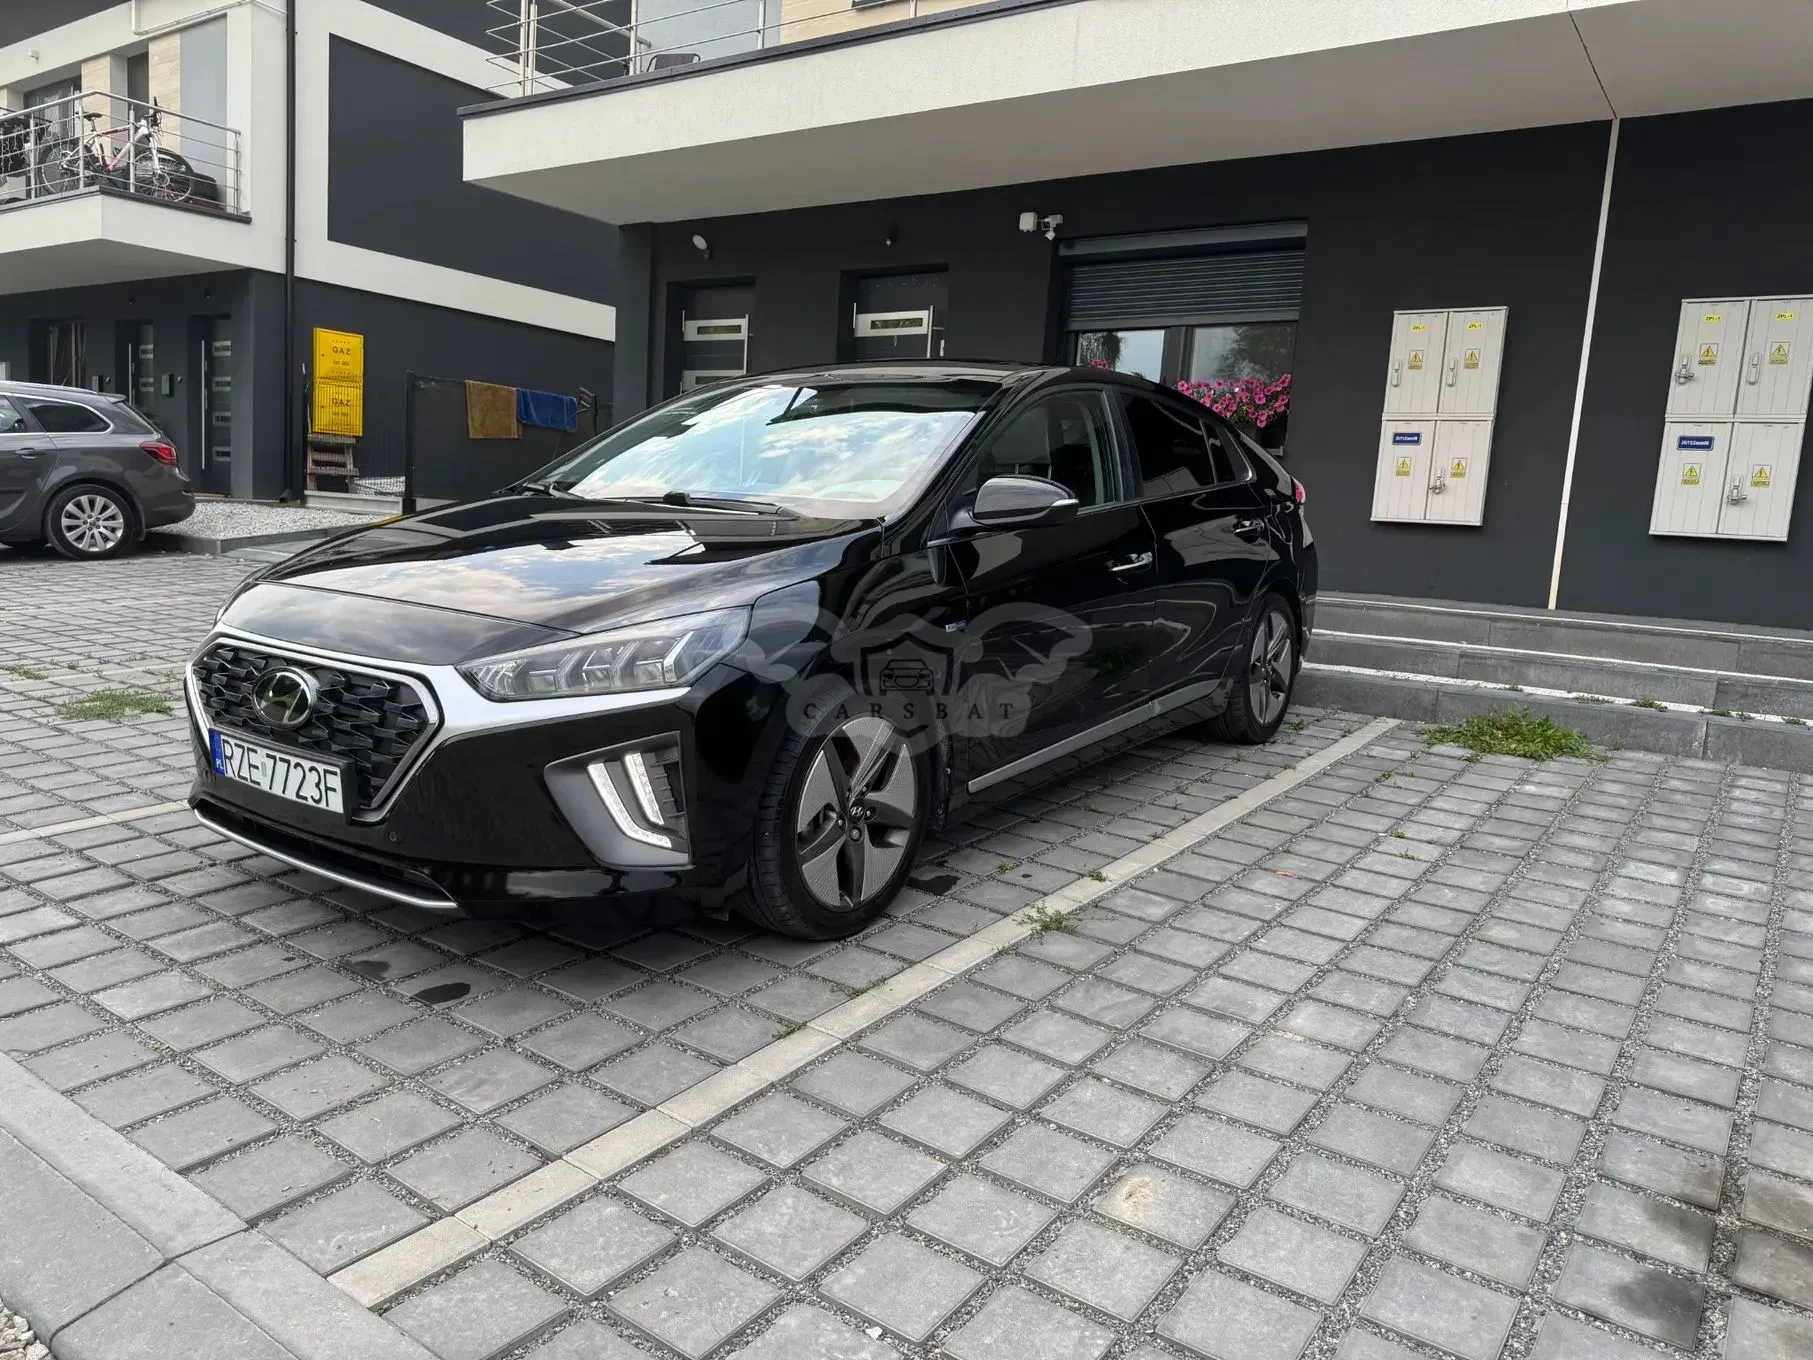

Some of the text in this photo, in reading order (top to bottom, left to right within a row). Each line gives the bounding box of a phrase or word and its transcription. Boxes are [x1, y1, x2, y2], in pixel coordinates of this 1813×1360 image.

[332, 346, 351, 356] GAZ
[332, 397, 351, 407] GAZ
[222, 738, 338, 808] RZE 7723F
